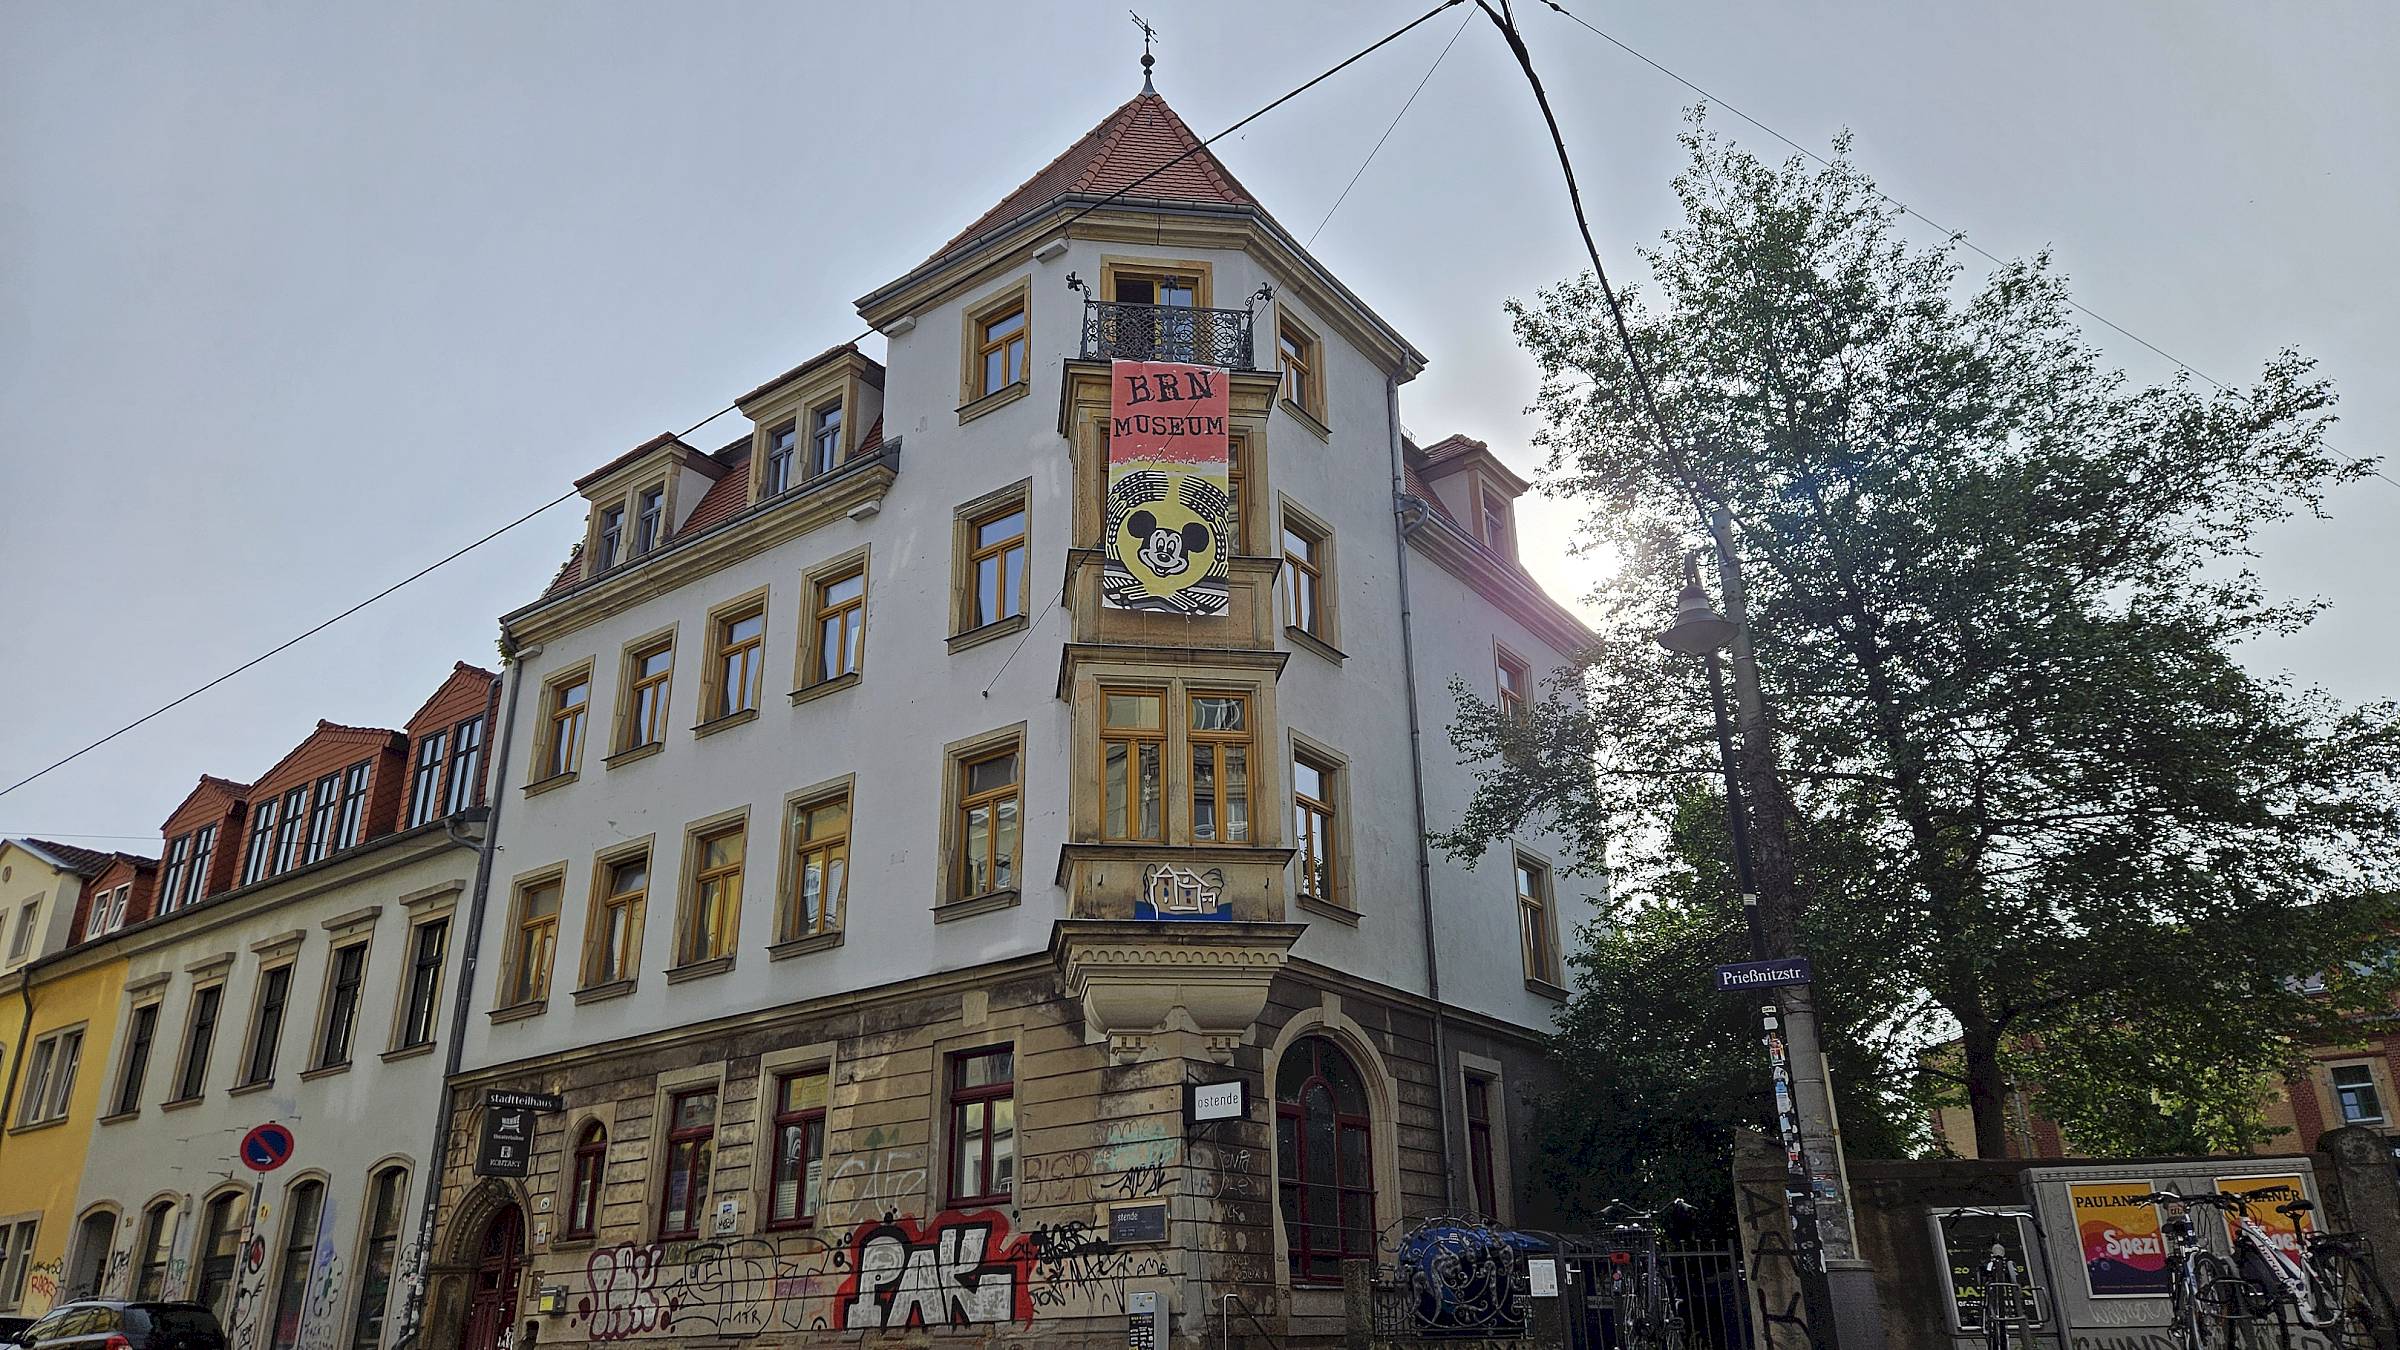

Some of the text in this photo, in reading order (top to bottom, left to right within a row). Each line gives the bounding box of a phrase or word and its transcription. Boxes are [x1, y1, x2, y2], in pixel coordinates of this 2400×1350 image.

[1124, 371, 1214, 406] BRN
[1113, 415, 1226, 437] MUSEUM
[1722, 967, 1805, 986] Prießnitzstr.
[490, 1094, 553, 1108] stadtteilhaus
[1198, 1093, 1239, 1108] ostende
[489, 1159, 521, 1168] KONTAKT
[2103, 1230, 2161, 1259] Spezi
